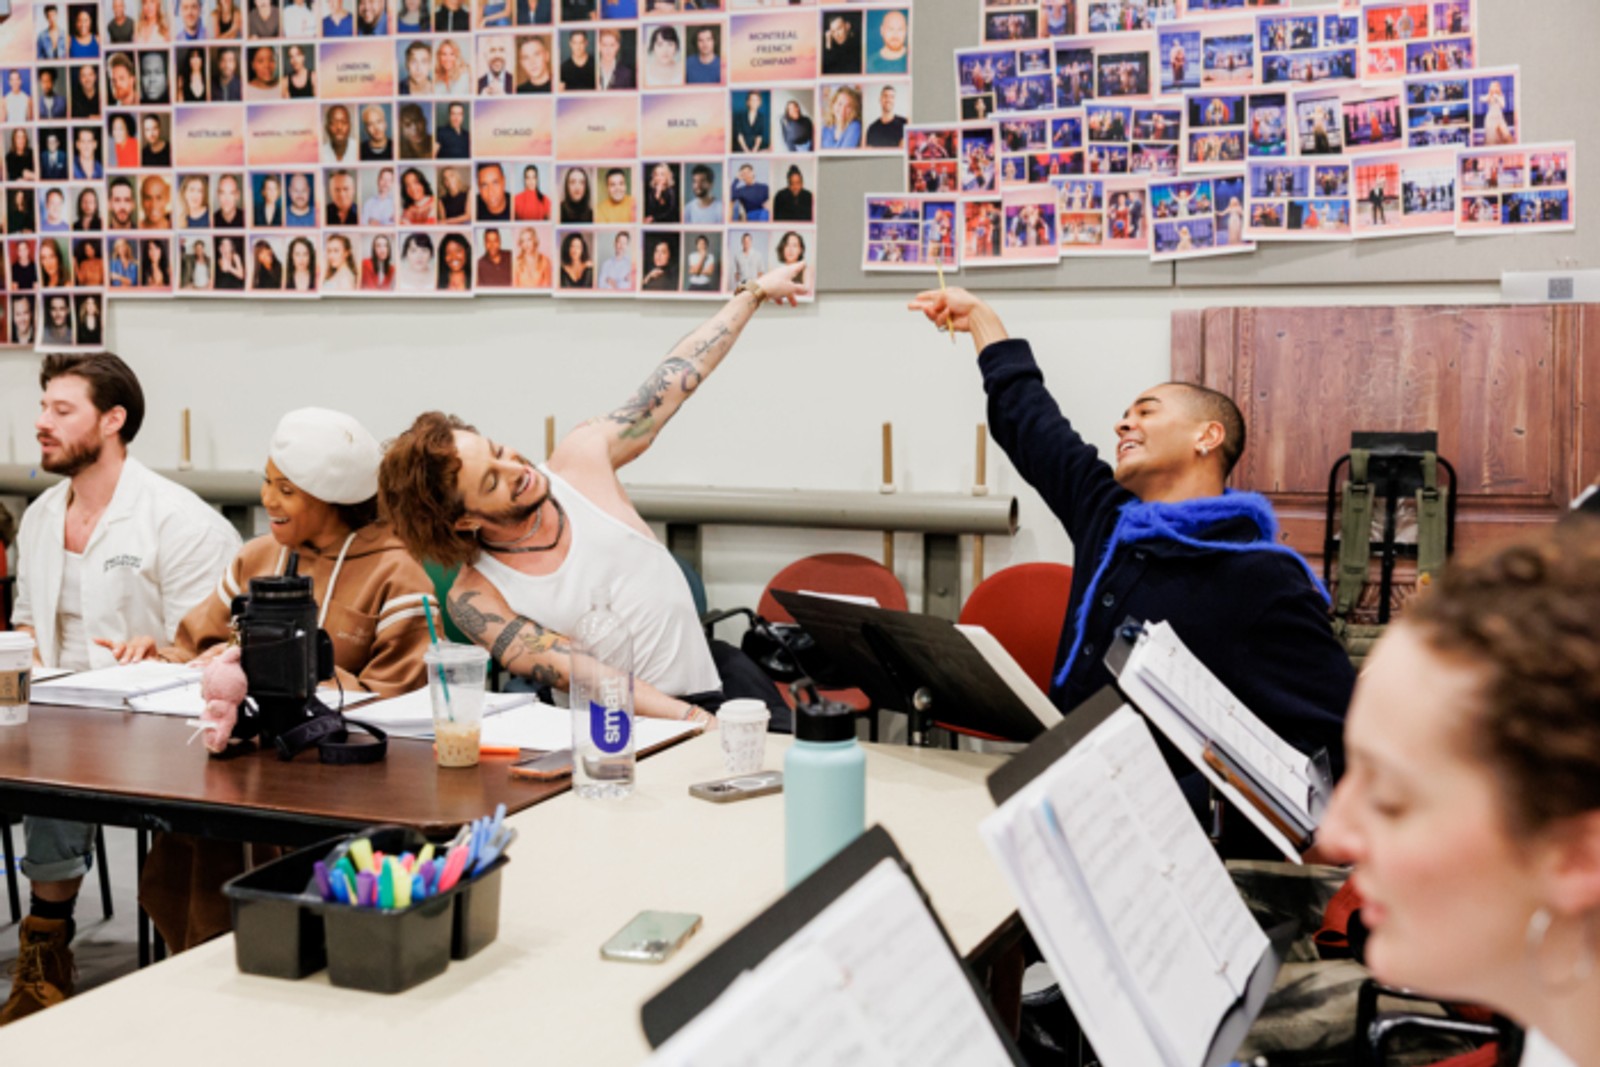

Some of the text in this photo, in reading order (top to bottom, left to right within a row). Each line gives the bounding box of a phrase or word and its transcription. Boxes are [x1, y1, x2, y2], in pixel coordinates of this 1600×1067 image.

[748, 31, 798, 41] MONTREAL
[749, 57, 797, 68] COMPANY
[493, 127, 533, 137] CHICAGO
